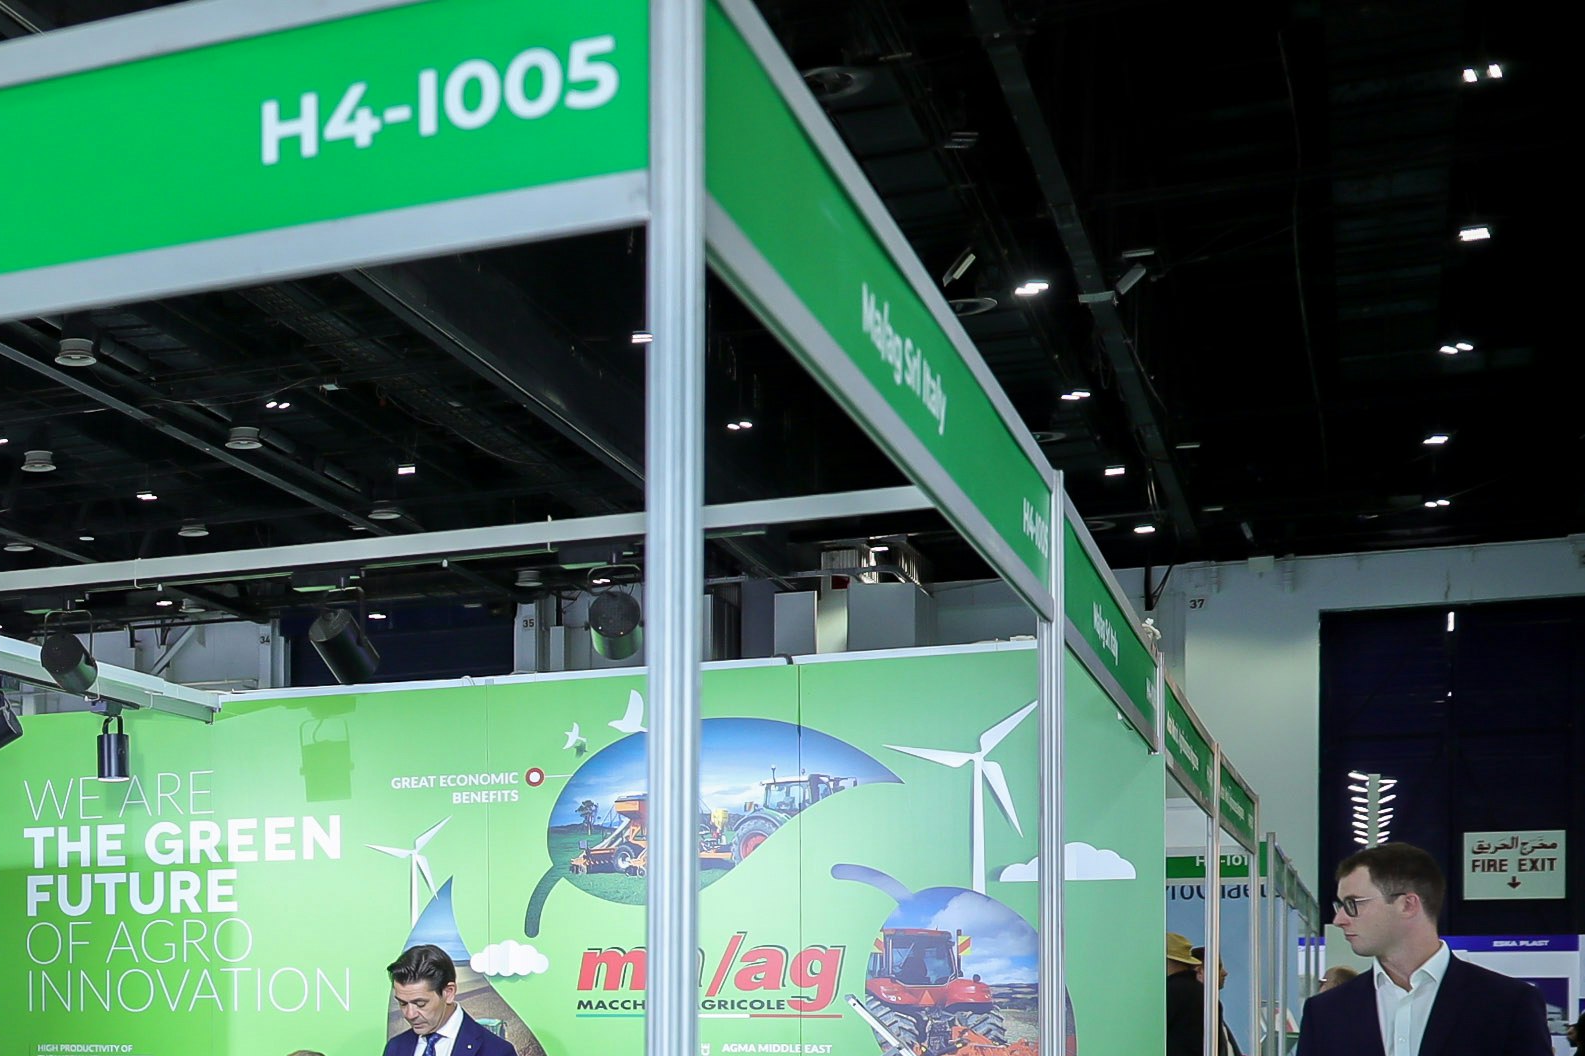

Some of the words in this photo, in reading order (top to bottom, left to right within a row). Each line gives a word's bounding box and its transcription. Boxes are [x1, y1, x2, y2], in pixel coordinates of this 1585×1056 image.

[261, 34, 619, 165] H4-I005
[922, 359, 946, 435] Italy
[1189, 599, 1205, 609] 37
[24, 777, 103, 821] WE
[118, 770, 215, 819] ARE
[391, 775, 436, 789] GREAT
[439, 772, 518, 787] ECONOMIC
[452, 790, 519, 804] BENEFITS
[24, 823, 126, 868] THE
[144, 815, 341, 866] GREEN
[1472, 858, 1508, 872] FIRE
[1518, 857, 1557, 872] EXIT
[27, 868, 238, 917] FUTURE
[26, 921, 92, 965] OF
[105, 917, 253, 964] AGRO
[28, 966, 351, 1012] INNOVATION
[576, 931, 846, 1012] m/ag
[37, 1044, 58, 1052] HIGH
[60, 1044, 120, 1052] PRODUCTIVITY
[722, 1044, 756, 1052] AGMA
[758, 1044, 801, 1053] MIDDLE
[805, 1045, 833, 1054] EAST
